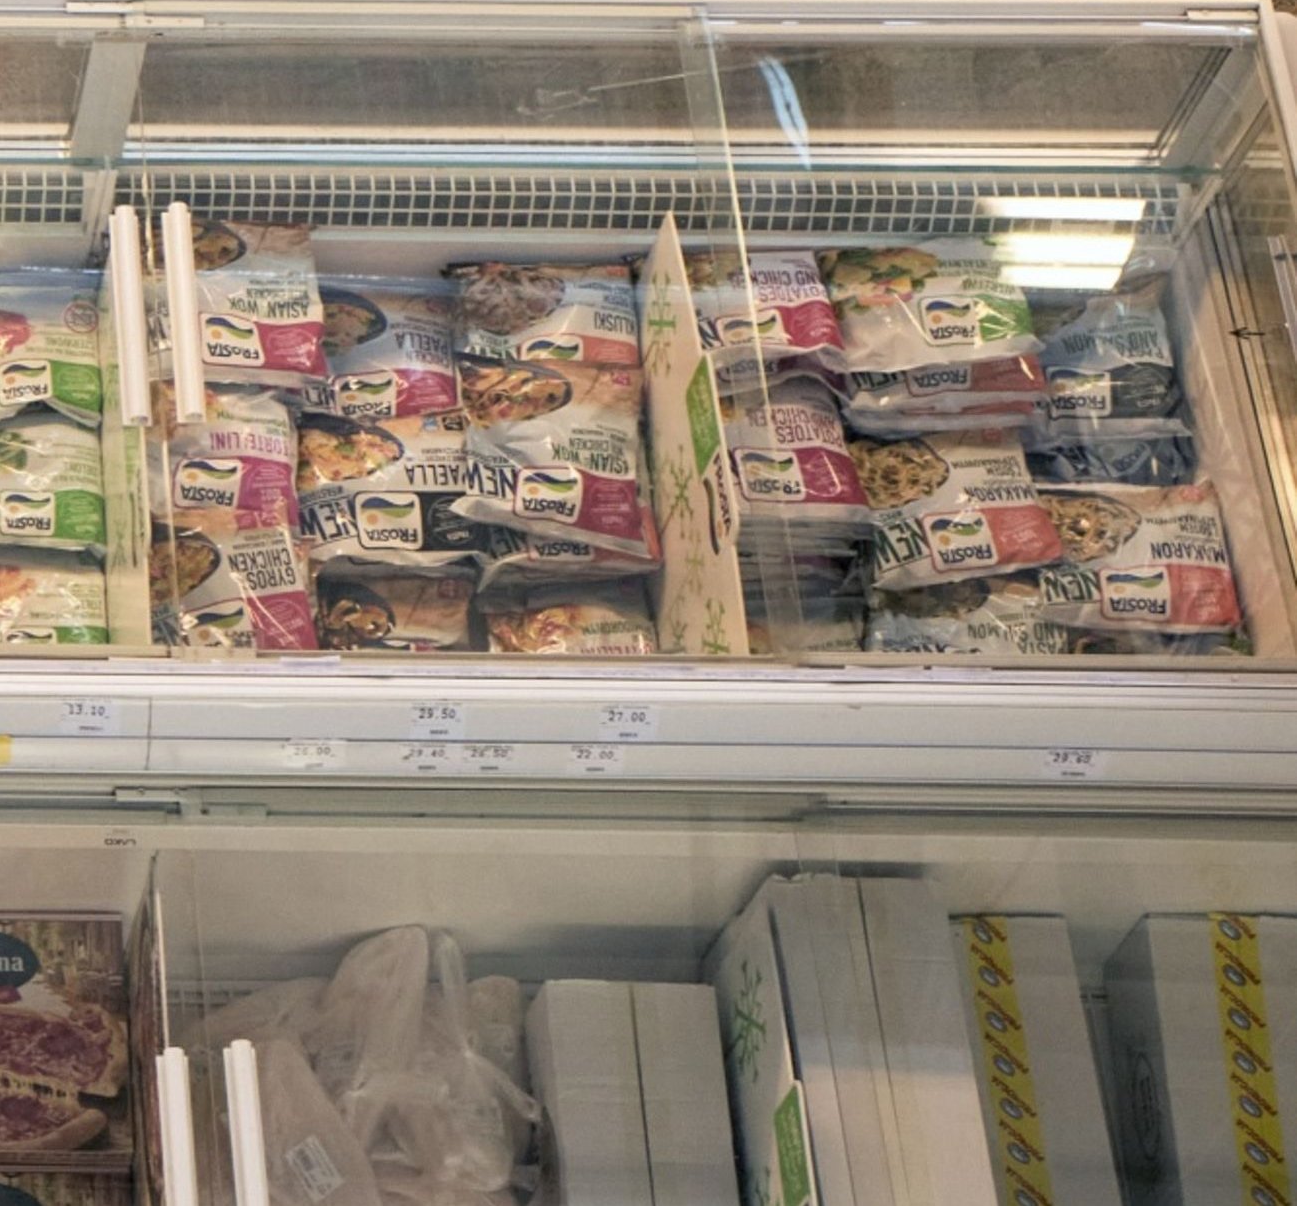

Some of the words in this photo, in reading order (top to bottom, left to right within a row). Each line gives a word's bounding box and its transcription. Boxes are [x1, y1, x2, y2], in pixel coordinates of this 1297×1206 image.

[228, 297, 259, 313] WOK
[260, 298, 310, 318] ASIAN
[594, 312, 636, 332] KLUSKI
[395, 330, 444, 350] PAELLA
[777, 427, 843, 446] POTATOES
[468, 462, 518, 497] NEW
[965, 485, 1037, 501] MAKARON
[301, 497, 360, 541] NEW
[874, 517, 930, 570] NEW
[1152, 542, 1226, 563] MAKARON
[229, 548, 292, 571] CHICKEN
[248, 569, 297, 591] GYROS
[1040, 567, 1099, 602] NEW
[68, 704, 105, 716] 13.10
[418, 708, 456, 719] 29.50
[608, 711, 646, 723] 27.00
[576, 749, 614, 760] 22.00
